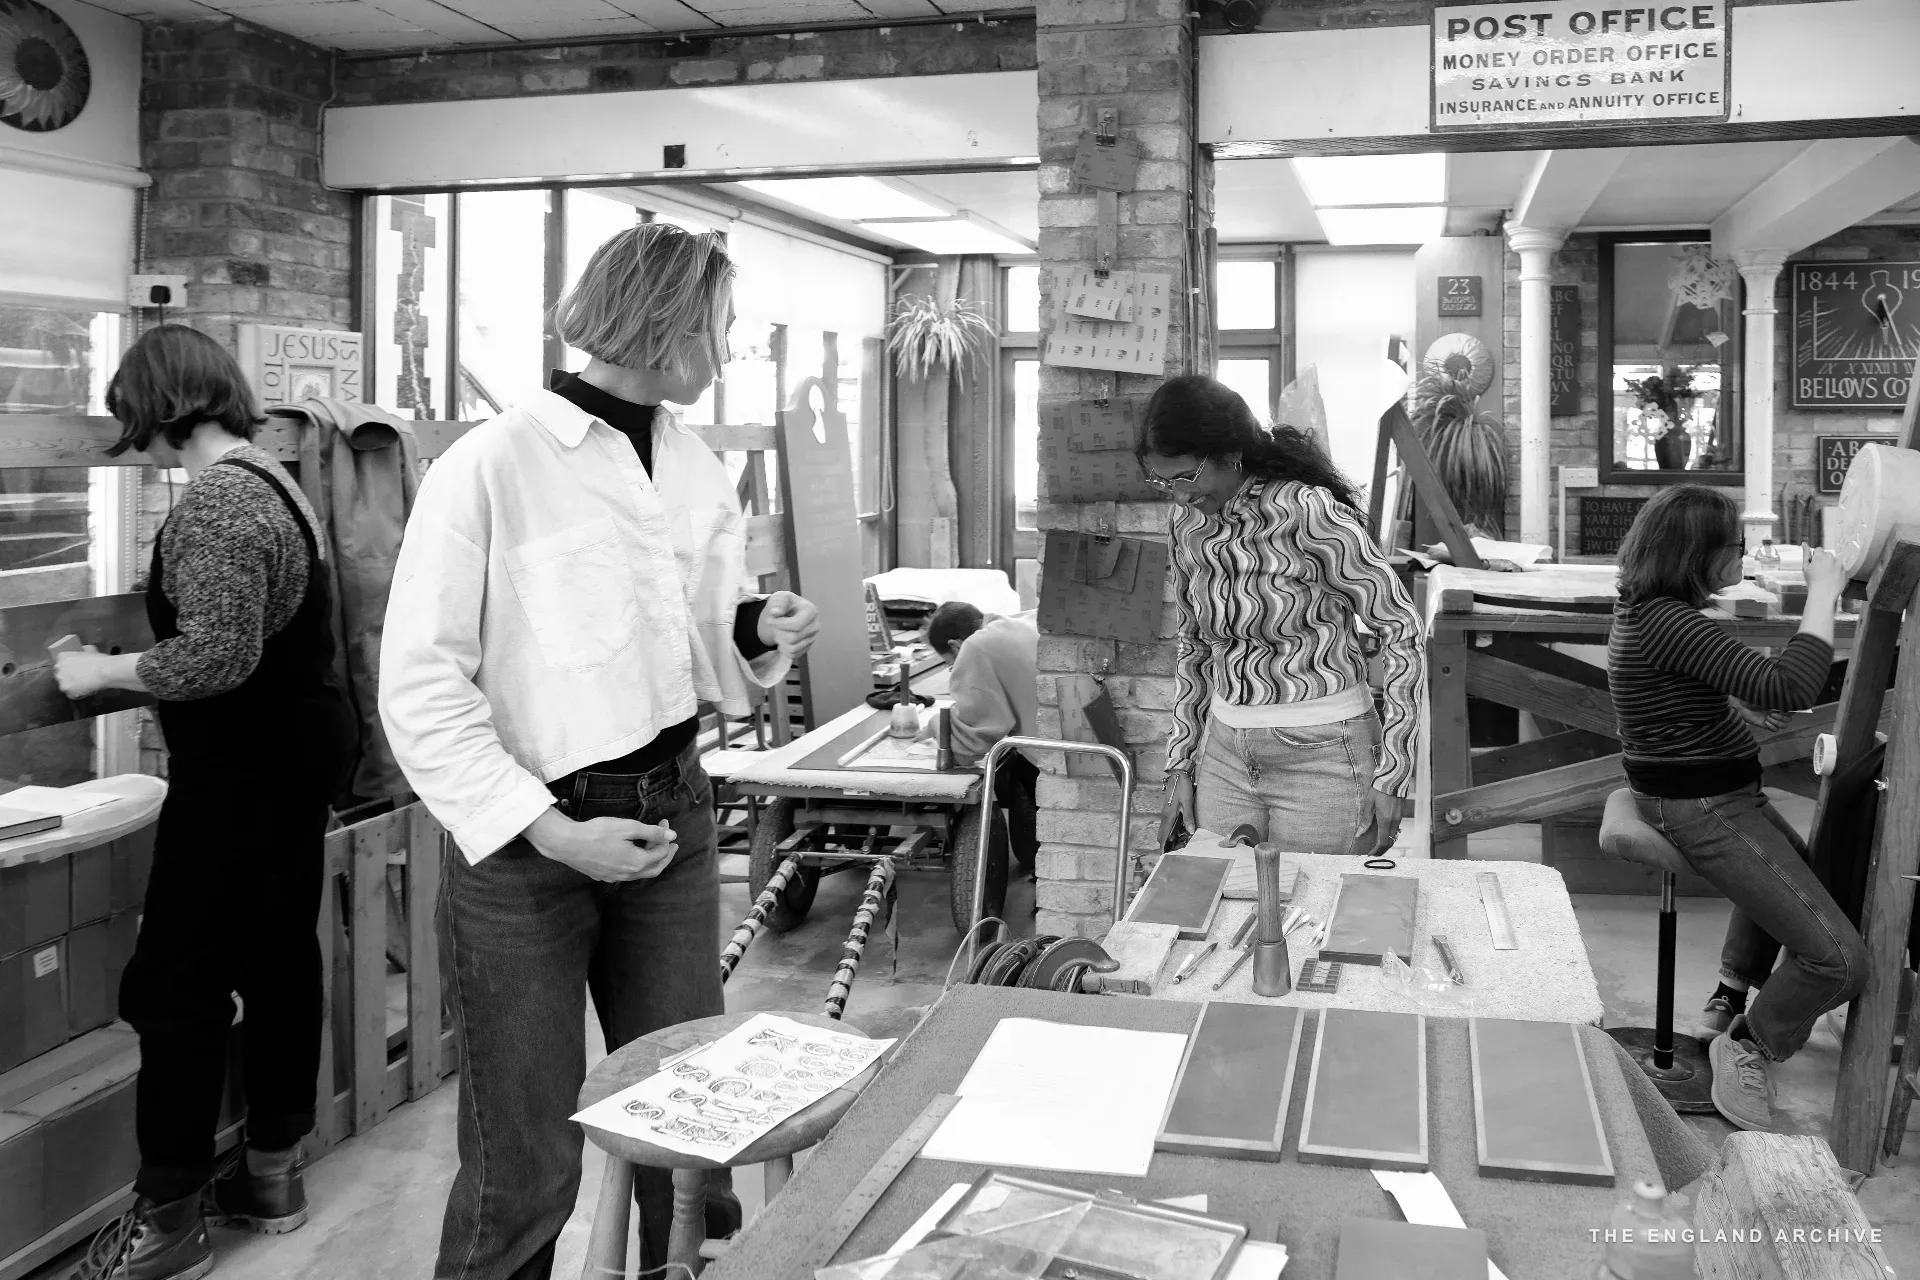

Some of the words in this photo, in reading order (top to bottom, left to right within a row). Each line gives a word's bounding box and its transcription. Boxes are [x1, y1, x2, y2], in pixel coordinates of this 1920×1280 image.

[1447, 13, 1553, 42] POST
[1568, 5, 1715, 36] OFFICE
[1443, 50, 1521, 70] MONEY
[1532, 46, 1615, 66] ORDER
[1626, 42, 1718, 62] OFFICE
[1471, 73, 1592, 91] SAVINGS
[1610, 69, 1685, 85] BANK
[1440, 98, 1537, 114] INSURANCE
[1539, 102, 1565, 110] AND
[1567, 94, 1645, 109] ANNUITY
[1652, 91, 1720, 106] OFFICE
[1447, 278, 1470, 295] 23
[1799, 271, 1859, 291] 1844
[267, 333, 339, 360] JESUS
[1799, 377, 1879, 399] BELLOWS
[1584, 501, 1599, 513] TO
[1602, 501, 1633, 513] HAVE
